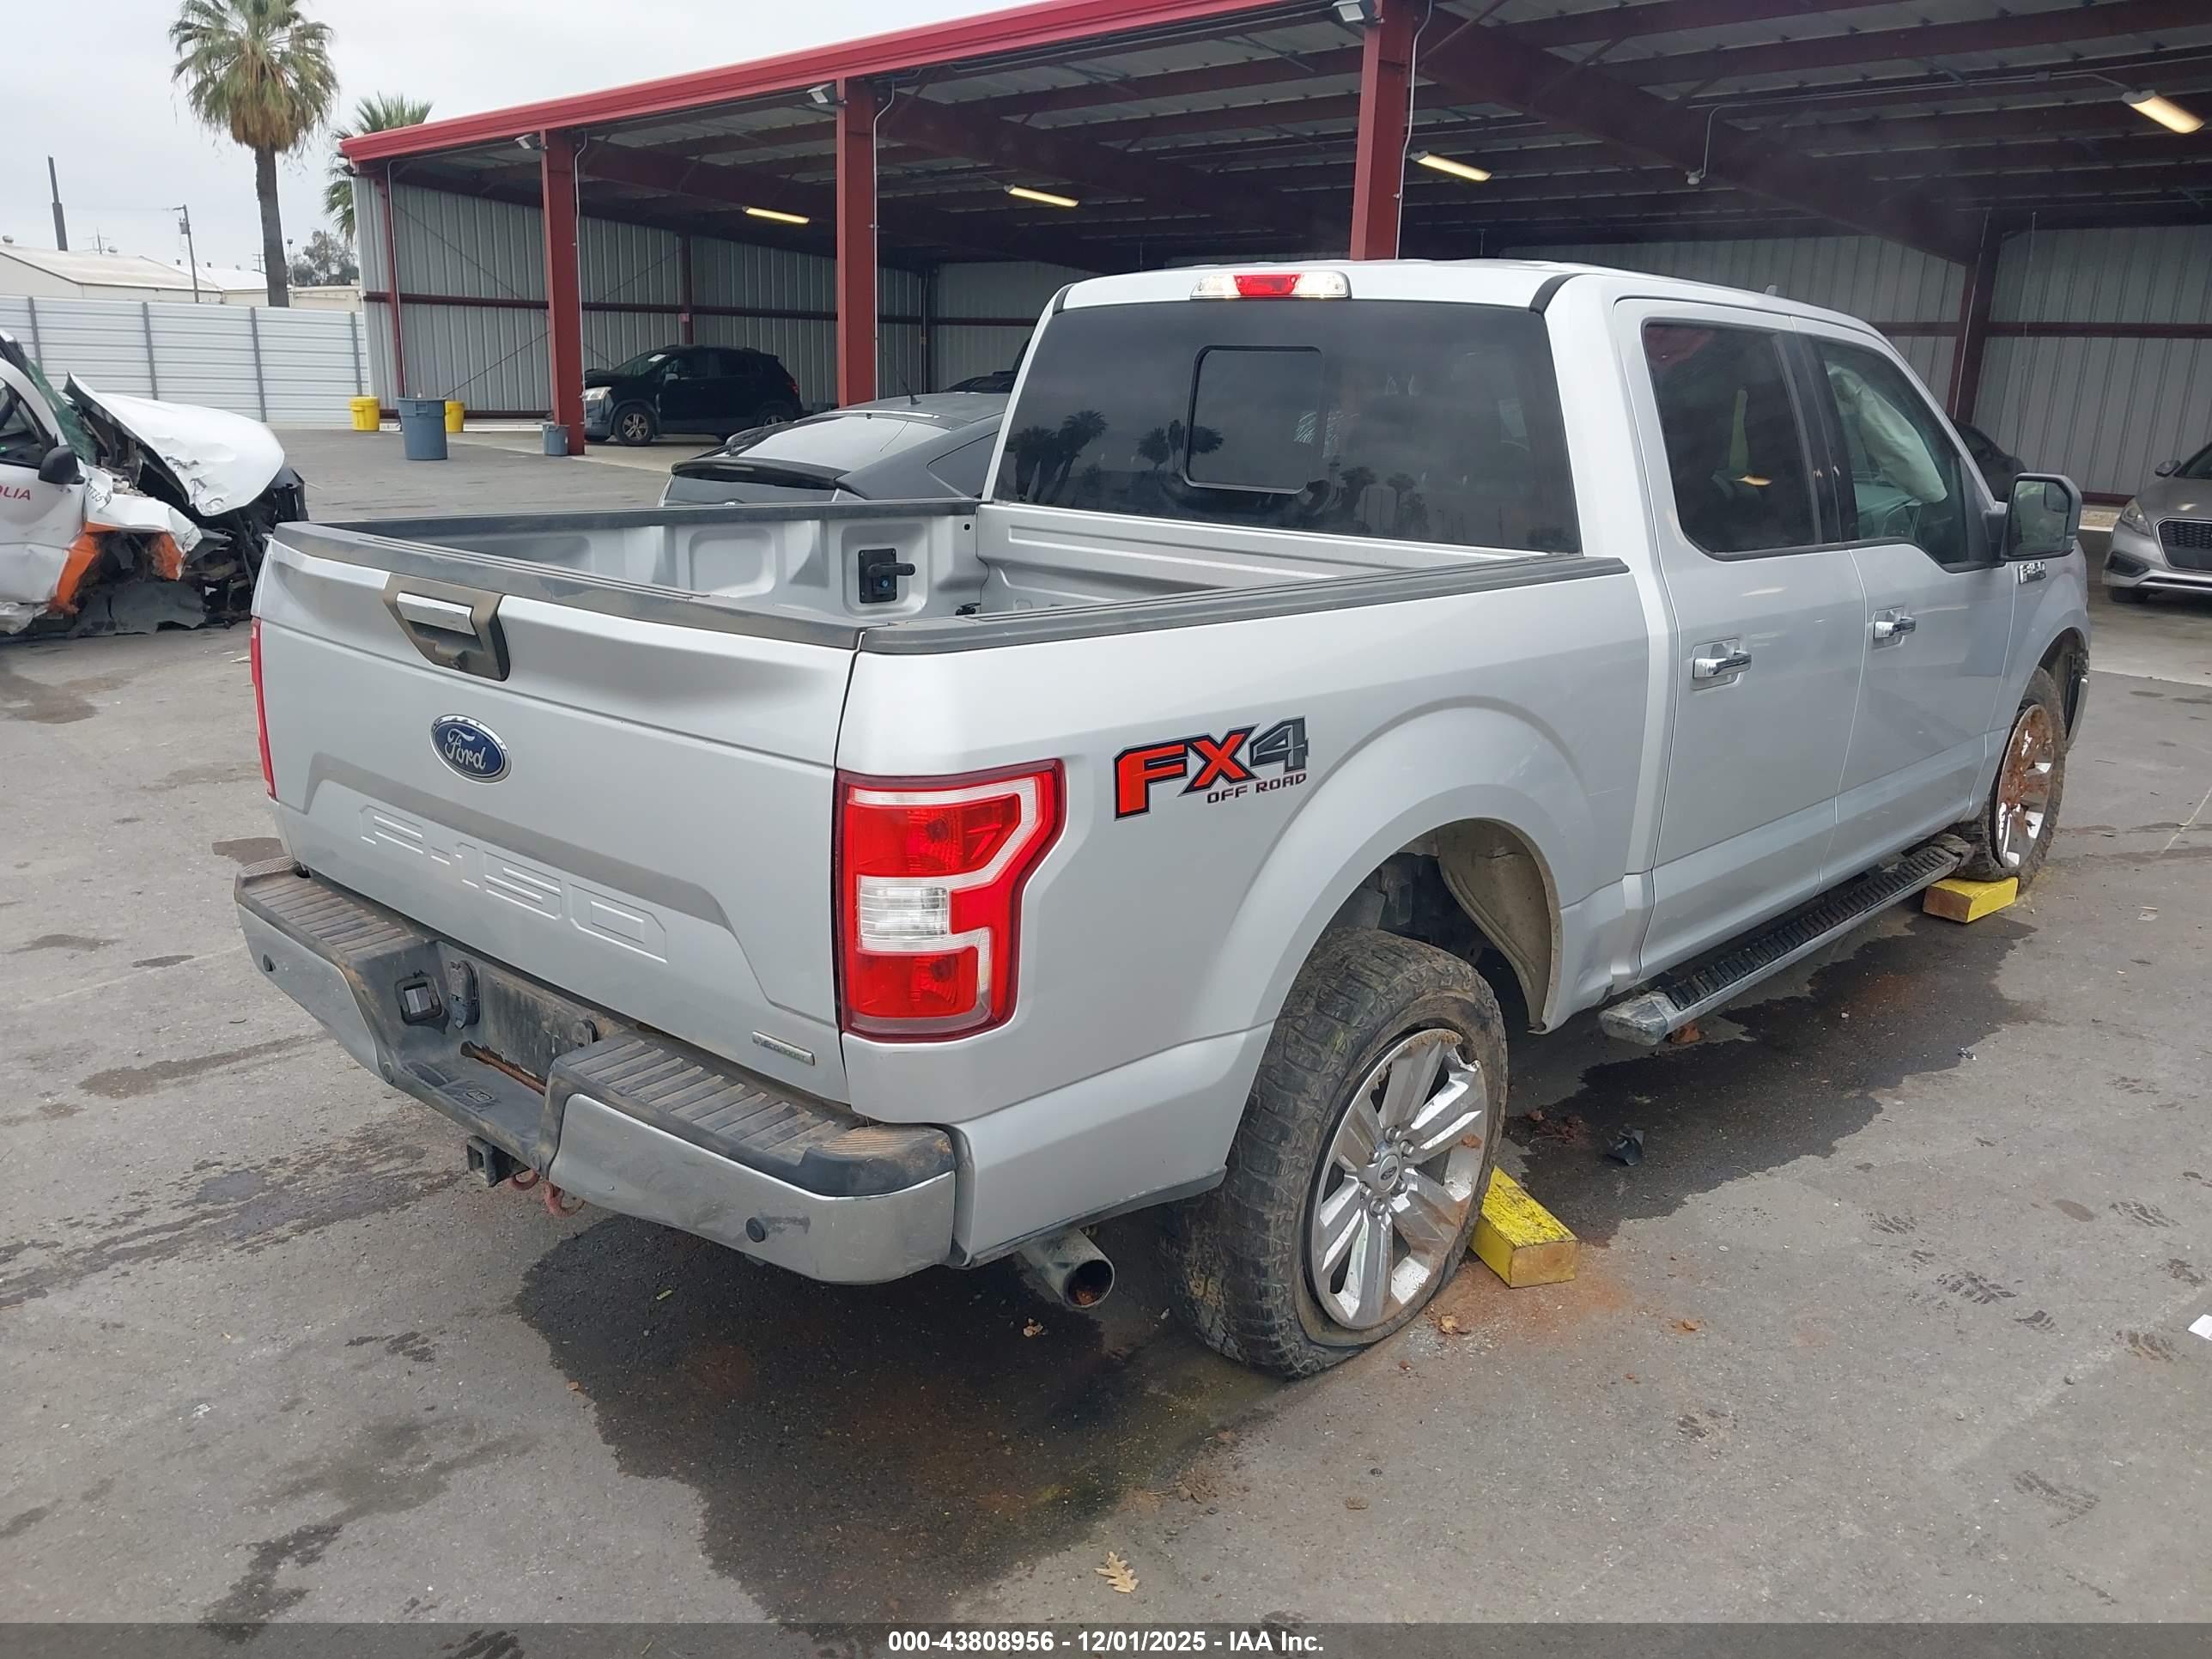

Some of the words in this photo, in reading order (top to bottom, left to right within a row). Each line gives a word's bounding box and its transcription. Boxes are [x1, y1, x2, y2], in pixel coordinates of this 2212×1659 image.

[444, 727, 486, 770] Ford
[1113, 715, 1309, 822] FX4
[1206, 785, 1248, 804] OFF
[1255, 773, 1307, 793] ROAD
[360, 804, 669, 963] F-150
